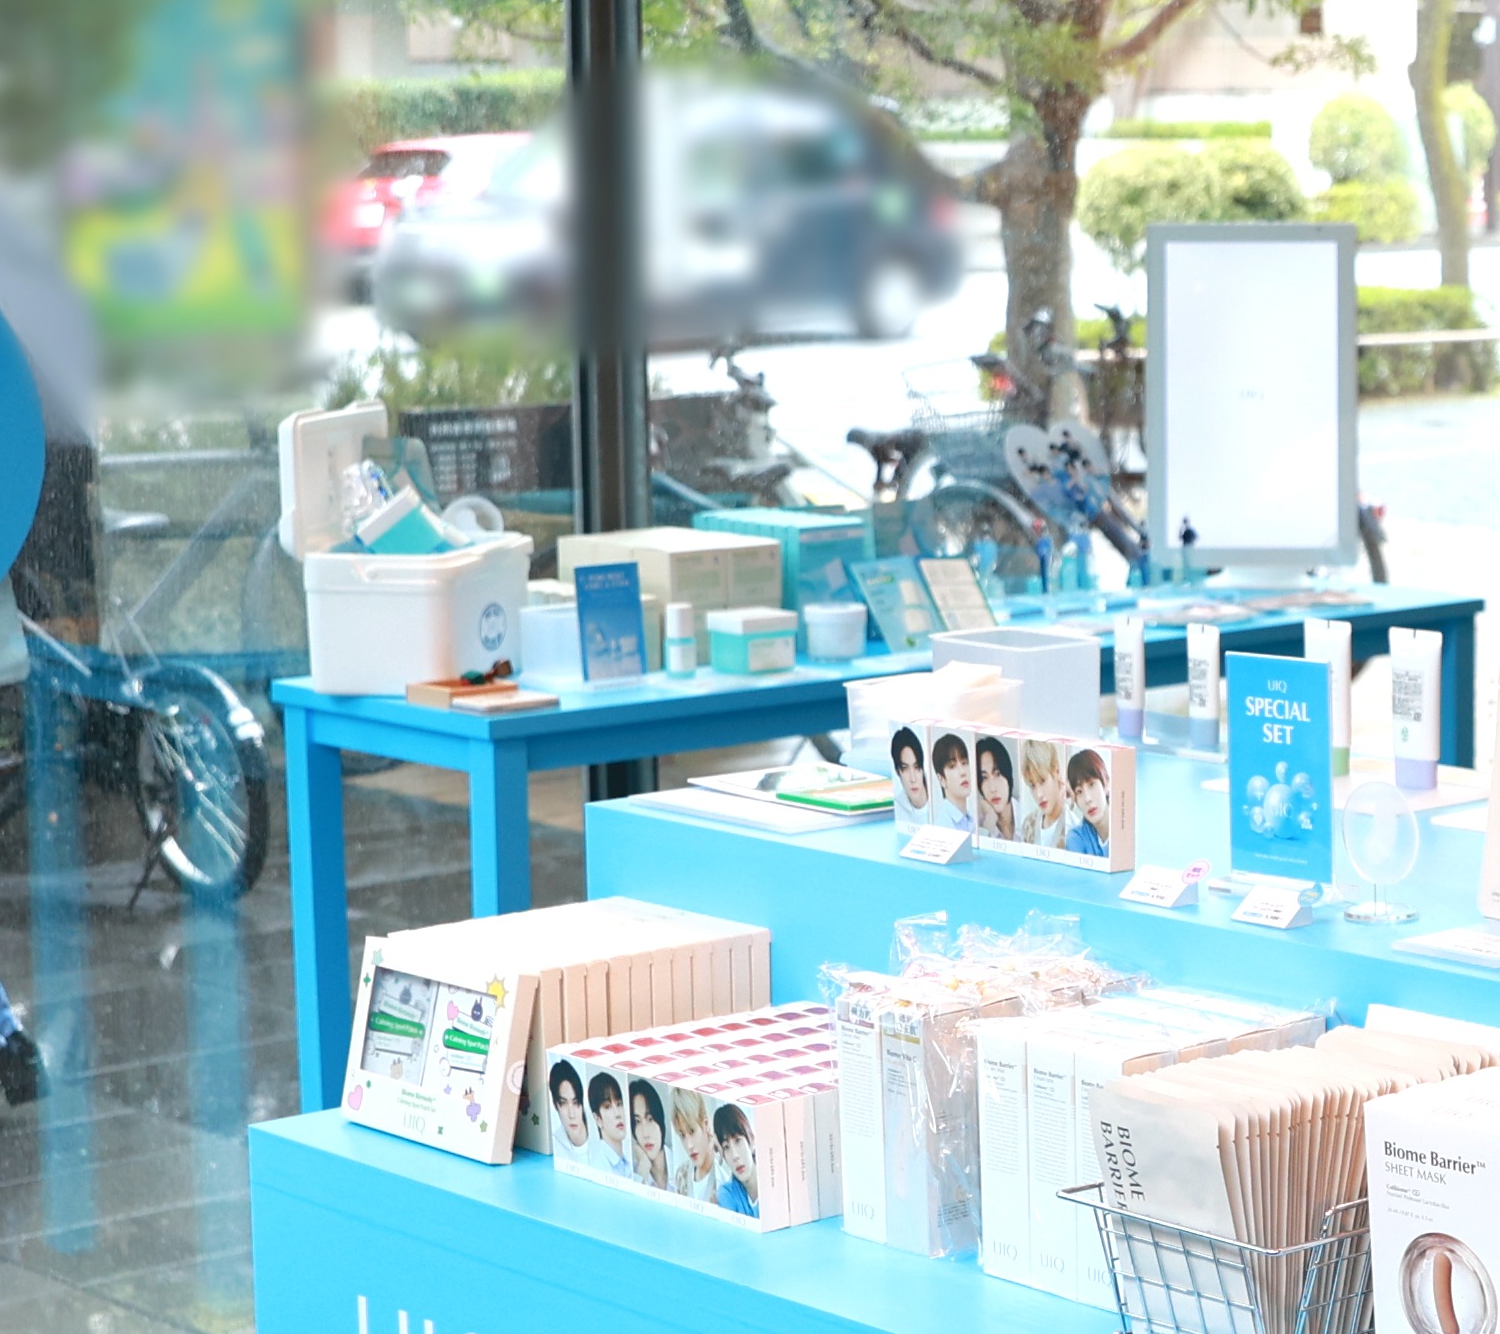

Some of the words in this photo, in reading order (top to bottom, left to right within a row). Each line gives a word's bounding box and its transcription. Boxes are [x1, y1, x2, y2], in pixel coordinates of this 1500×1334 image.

[1245, 696, 1311, 723] SPECIAL
[1262, 722, 1295, 745] SET
[1116, 1125, 1146, 1202] BIOME
[1383, 1140, 1427, 1164] Biome
[1384, 1160, 1415, 1177] SHEET
[1416, 1169, 1447, 1186] MASK
